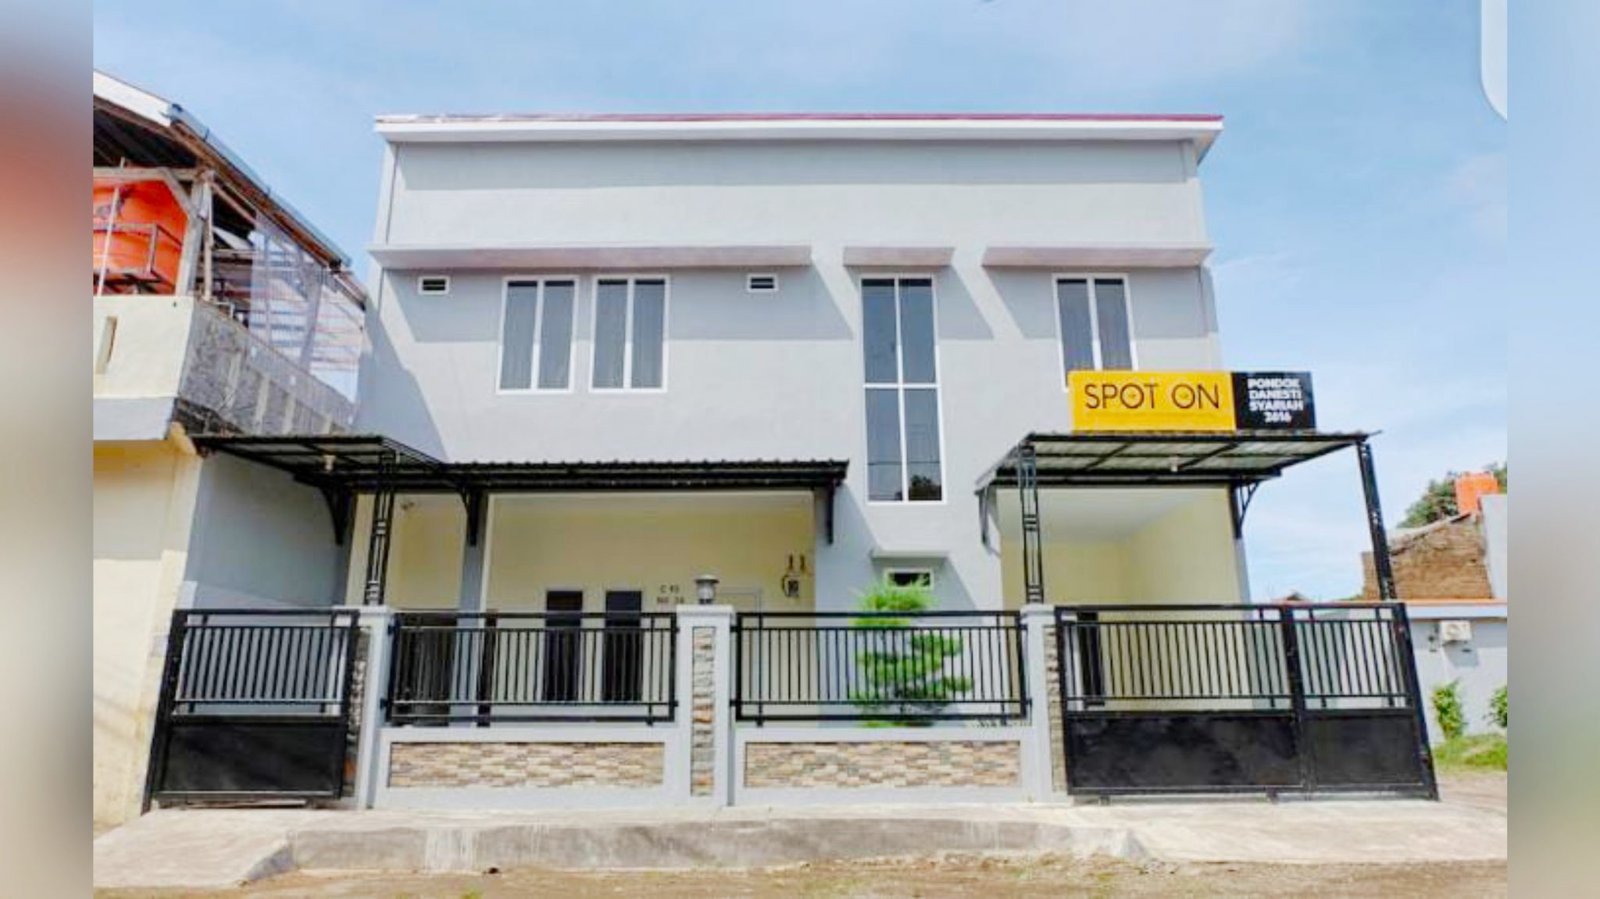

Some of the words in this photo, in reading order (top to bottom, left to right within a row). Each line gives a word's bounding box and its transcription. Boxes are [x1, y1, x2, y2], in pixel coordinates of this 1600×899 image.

[1247, 378, 1301, 389] PONDOK
[1084, 383, 1159, 410] SPOT
[1171, 383, 1219, 410] ON
[1249, 400, 1304, 411] SYARIAH
